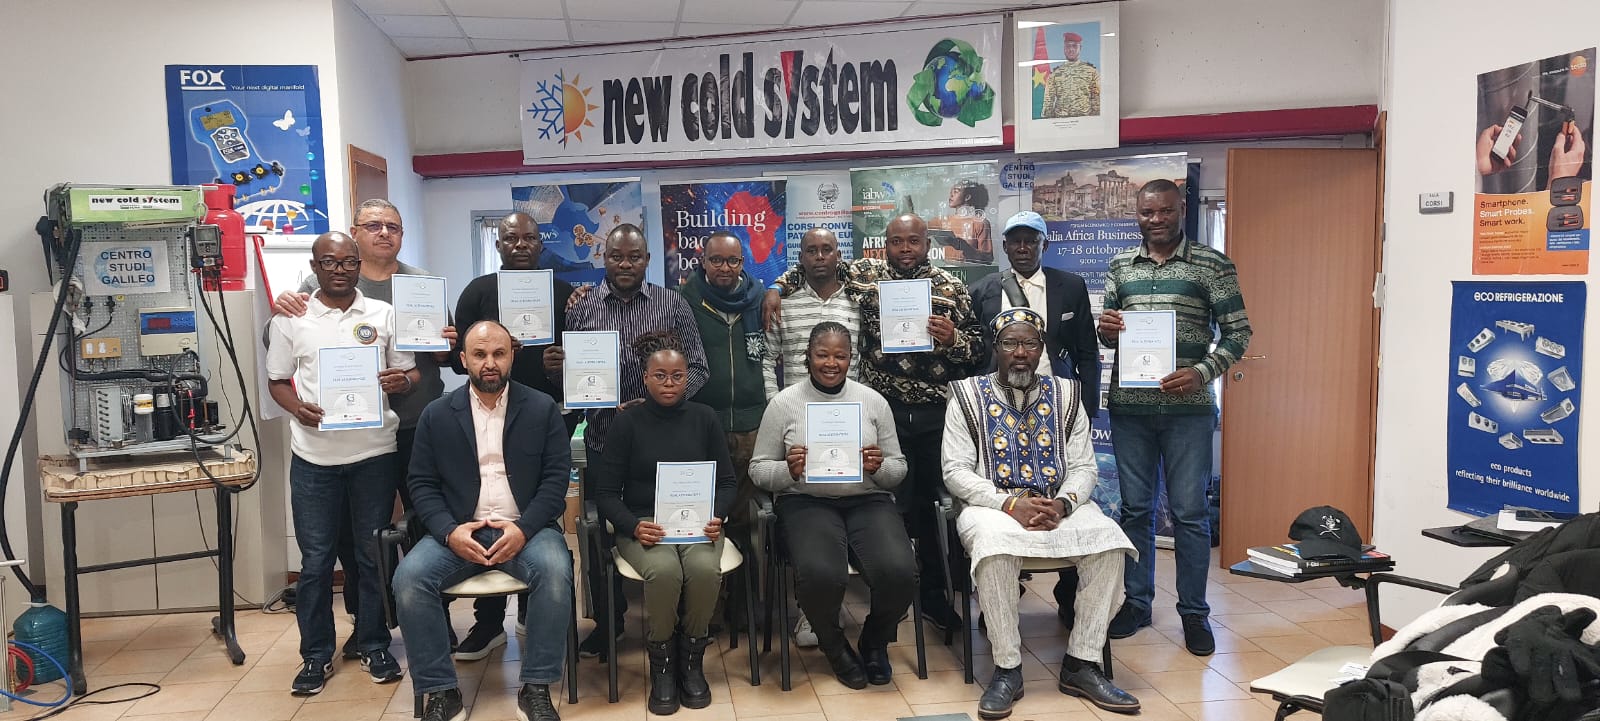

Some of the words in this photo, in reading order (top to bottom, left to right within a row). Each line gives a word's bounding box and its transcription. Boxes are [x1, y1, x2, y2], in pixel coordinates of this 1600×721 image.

[261, 84, 279, 92] digital
[602, 75, 673, 145] new
[681, 51, 755, 142] cold
[1003, 164, 1036, 172] CENTRO
[117, 196, 139, 204] cold
[1479, 199, 1529, 209] Smartphone.
[1479, 210, 1503, 218] Smart
[675, 208, 767, 232] Building
[1479, 219, 1503, 227] Smart
[1504, 217, 1526, 225] work.
[821, 222, 853, 230] CONVE
[1047, 231, 1064, 241] alia
[1065, 229, 1095, 241] Africa
[1097, 229, 1143, 241] Business
[100, 250, 152, 260] CENTRO
[109, 262, 146, 272] STUDI
[101, 274, 155, 285] GALILEO
[1490, 462, 1502, 471] eco
[1503, 464, 1532, 477] products
[1455, 469, 1485, 484] reflecting
[1485, 475, 1501, 486] their
[1502, 479, 1533, 494] brilliance
[1534, 487, 1571, 503] worldwide
